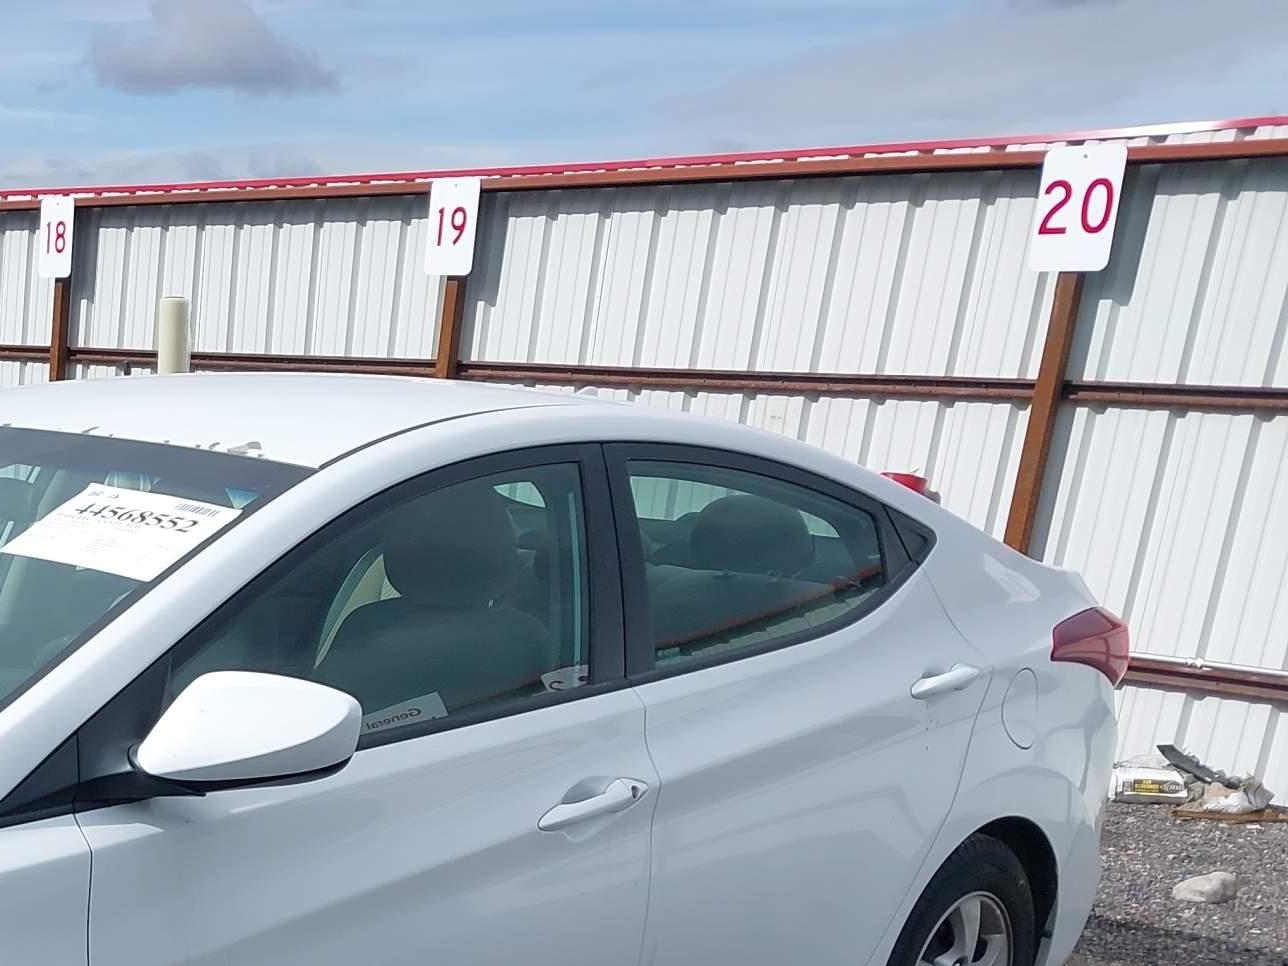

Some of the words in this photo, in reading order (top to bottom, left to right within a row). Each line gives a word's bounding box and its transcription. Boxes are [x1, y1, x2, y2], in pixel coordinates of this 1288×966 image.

[1038, 177, 1115, 236] 20
[46, 220, 66, 254] 18
[437, 206, 467, 247] 19
[74, 502, 200, 533] 44568552
